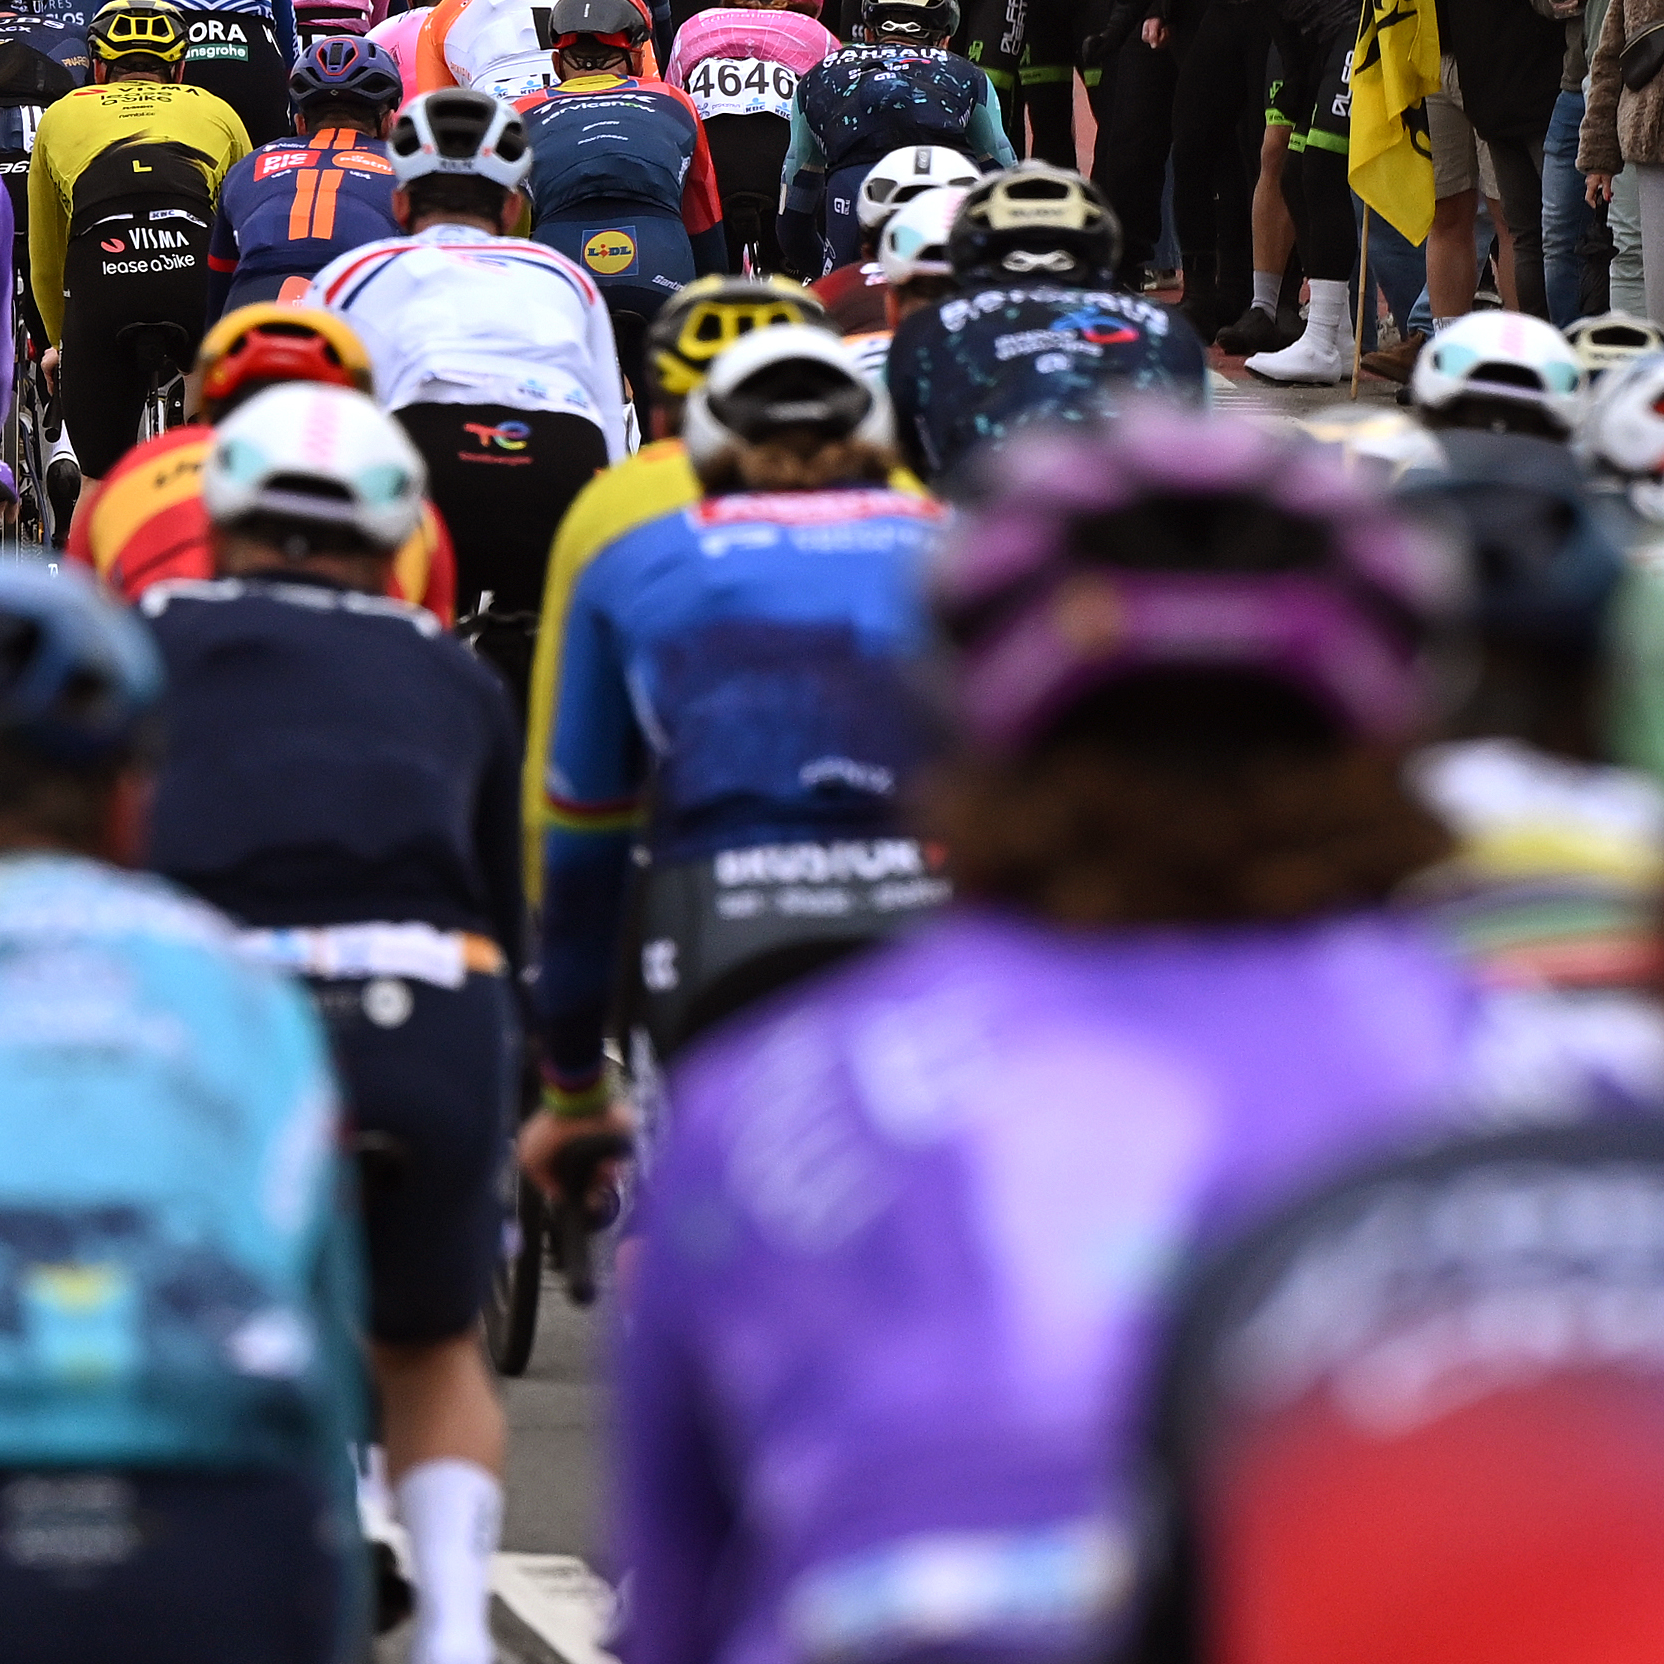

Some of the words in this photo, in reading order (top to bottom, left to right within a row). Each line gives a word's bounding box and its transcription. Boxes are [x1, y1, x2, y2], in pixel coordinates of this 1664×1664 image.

[188, 21, 247, 43] ORA
[185, 43, 246, 59] ansgrohe
[692, 66, 742, 98] 46
[745, 61, 794, 100] 46
[129, 228, 190, 250] VISMA
[102, 260, 147, 275] lease
[164, 253, 195, 269] bike
